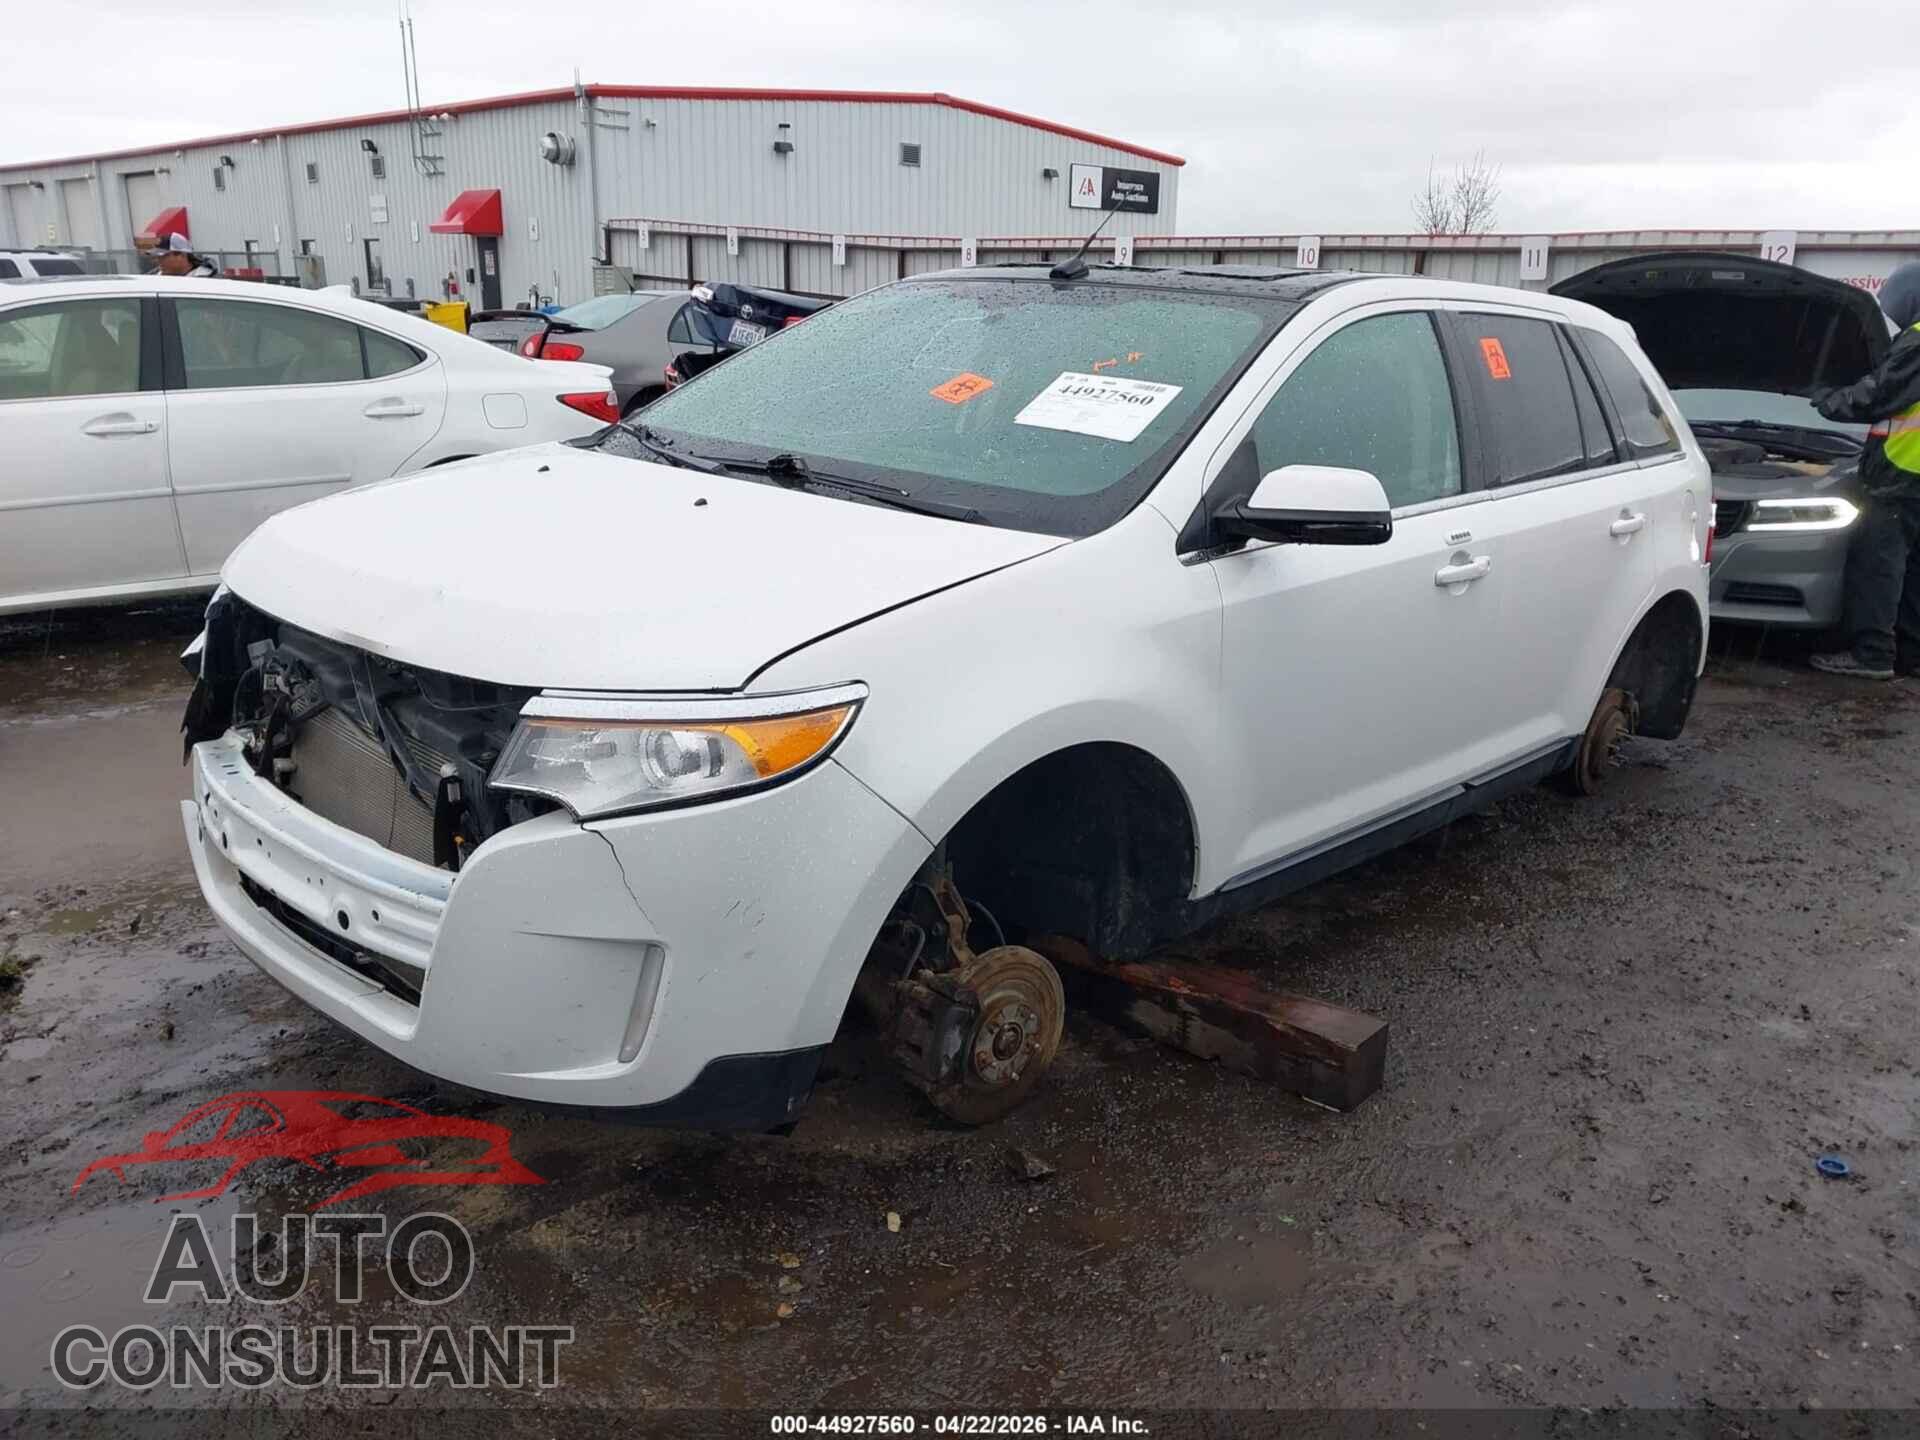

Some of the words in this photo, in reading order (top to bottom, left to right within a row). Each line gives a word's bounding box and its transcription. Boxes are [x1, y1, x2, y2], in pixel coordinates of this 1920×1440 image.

[966, 248, 972, 262] 8
[1121, 248, 1128, 262] 9
[1300, 248, 1315, 264] 10
[1526, 249, 1541, 268] 11
[1766, 246, 1789, 262] 12
[1058, 385, 1155, 406] 44927560
